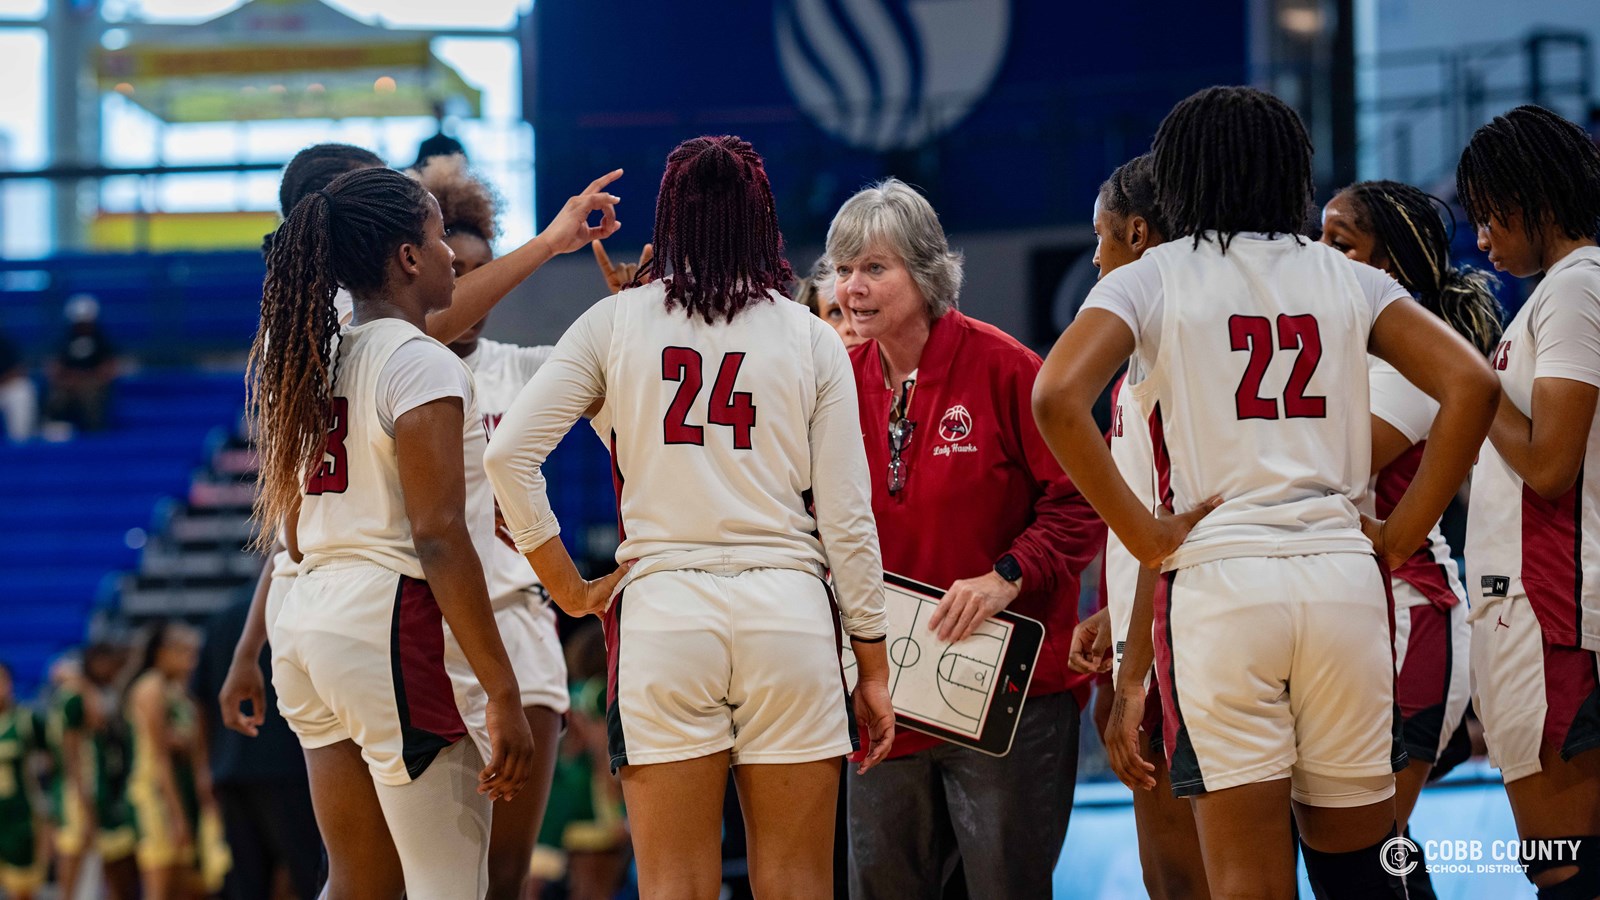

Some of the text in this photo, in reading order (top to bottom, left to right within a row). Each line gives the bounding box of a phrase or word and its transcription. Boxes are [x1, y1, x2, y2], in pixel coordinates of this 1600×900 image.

[662, 346, 757, 450] 24
[1228, 313, 1326, 420] 22
[933, 443, 978, 456] Lady Hawks
